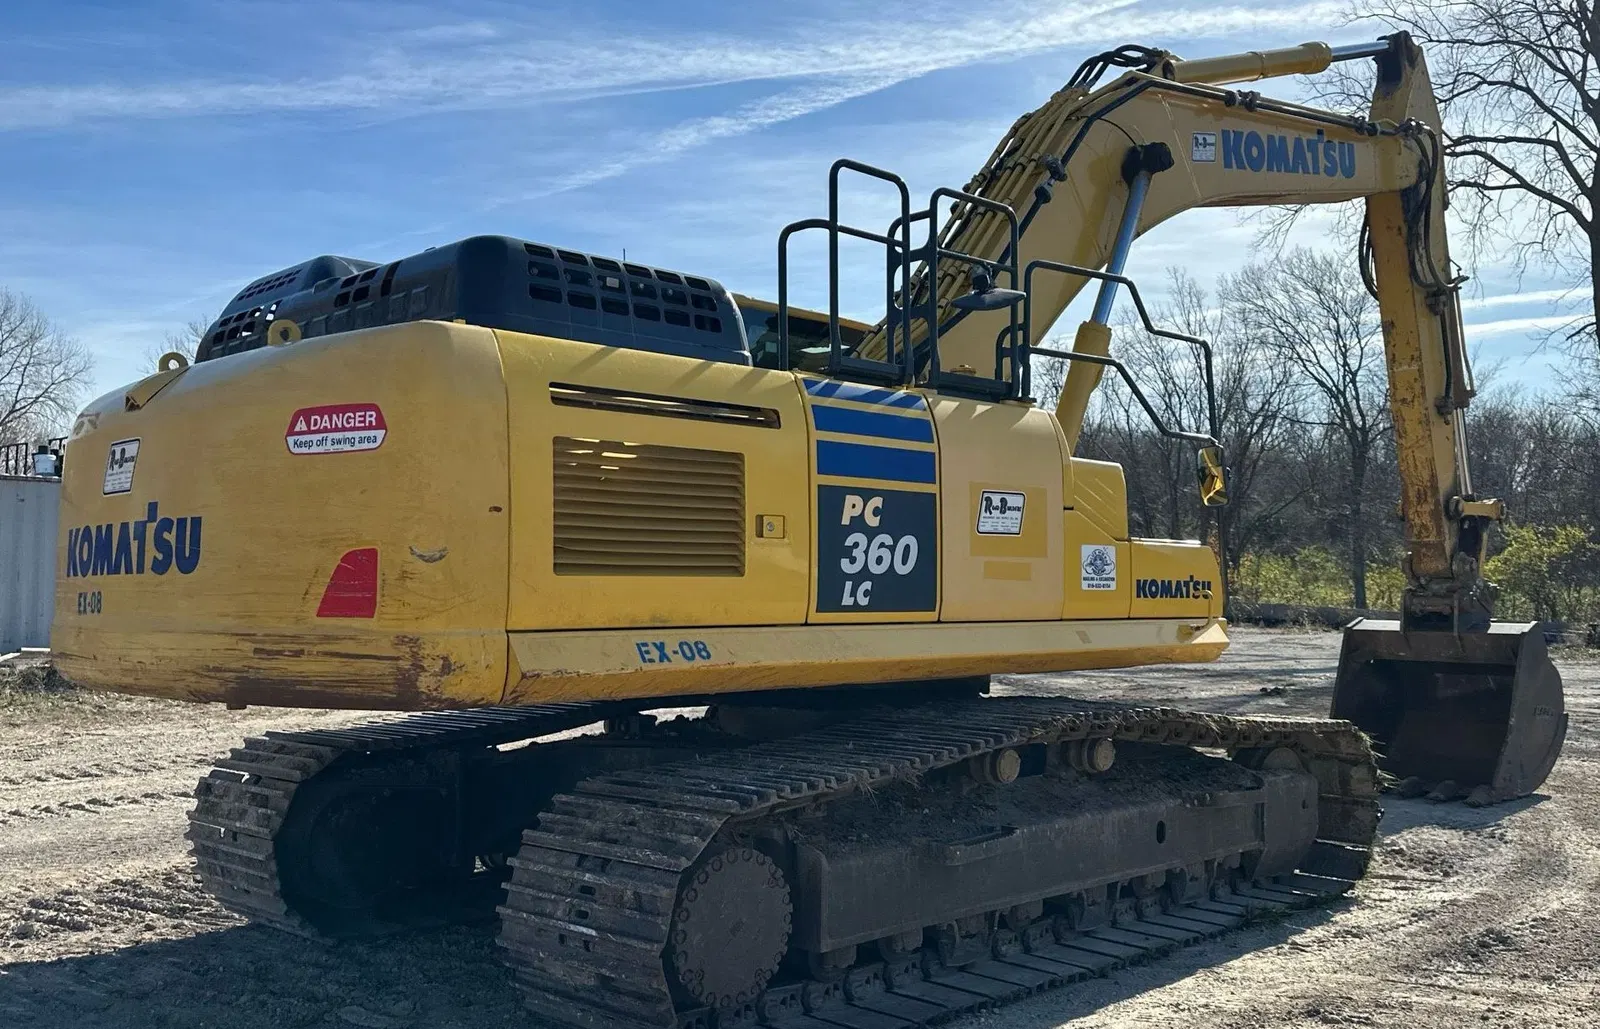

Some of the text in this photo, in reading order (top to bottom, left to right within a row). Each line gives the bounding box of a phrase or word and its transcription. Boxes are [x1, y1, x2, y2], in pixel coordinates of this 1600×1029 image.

[1221, 128, 1356, 179] KOMATSU
[310, 411, 377, 430] DANGER
[293, 434, 377, 450] Keep off swing area
[841, 494, 884, 527] PC
[66, 501, 202, 578] KOMATSU
[840, 532, 919, 575] 360
[841, 580, 873, 606] LC
[1136, 575, 1212, 599] KOMATSU
[77, 591, 103, 616] EX-08
[636, 640, 712, 663] EX-08
